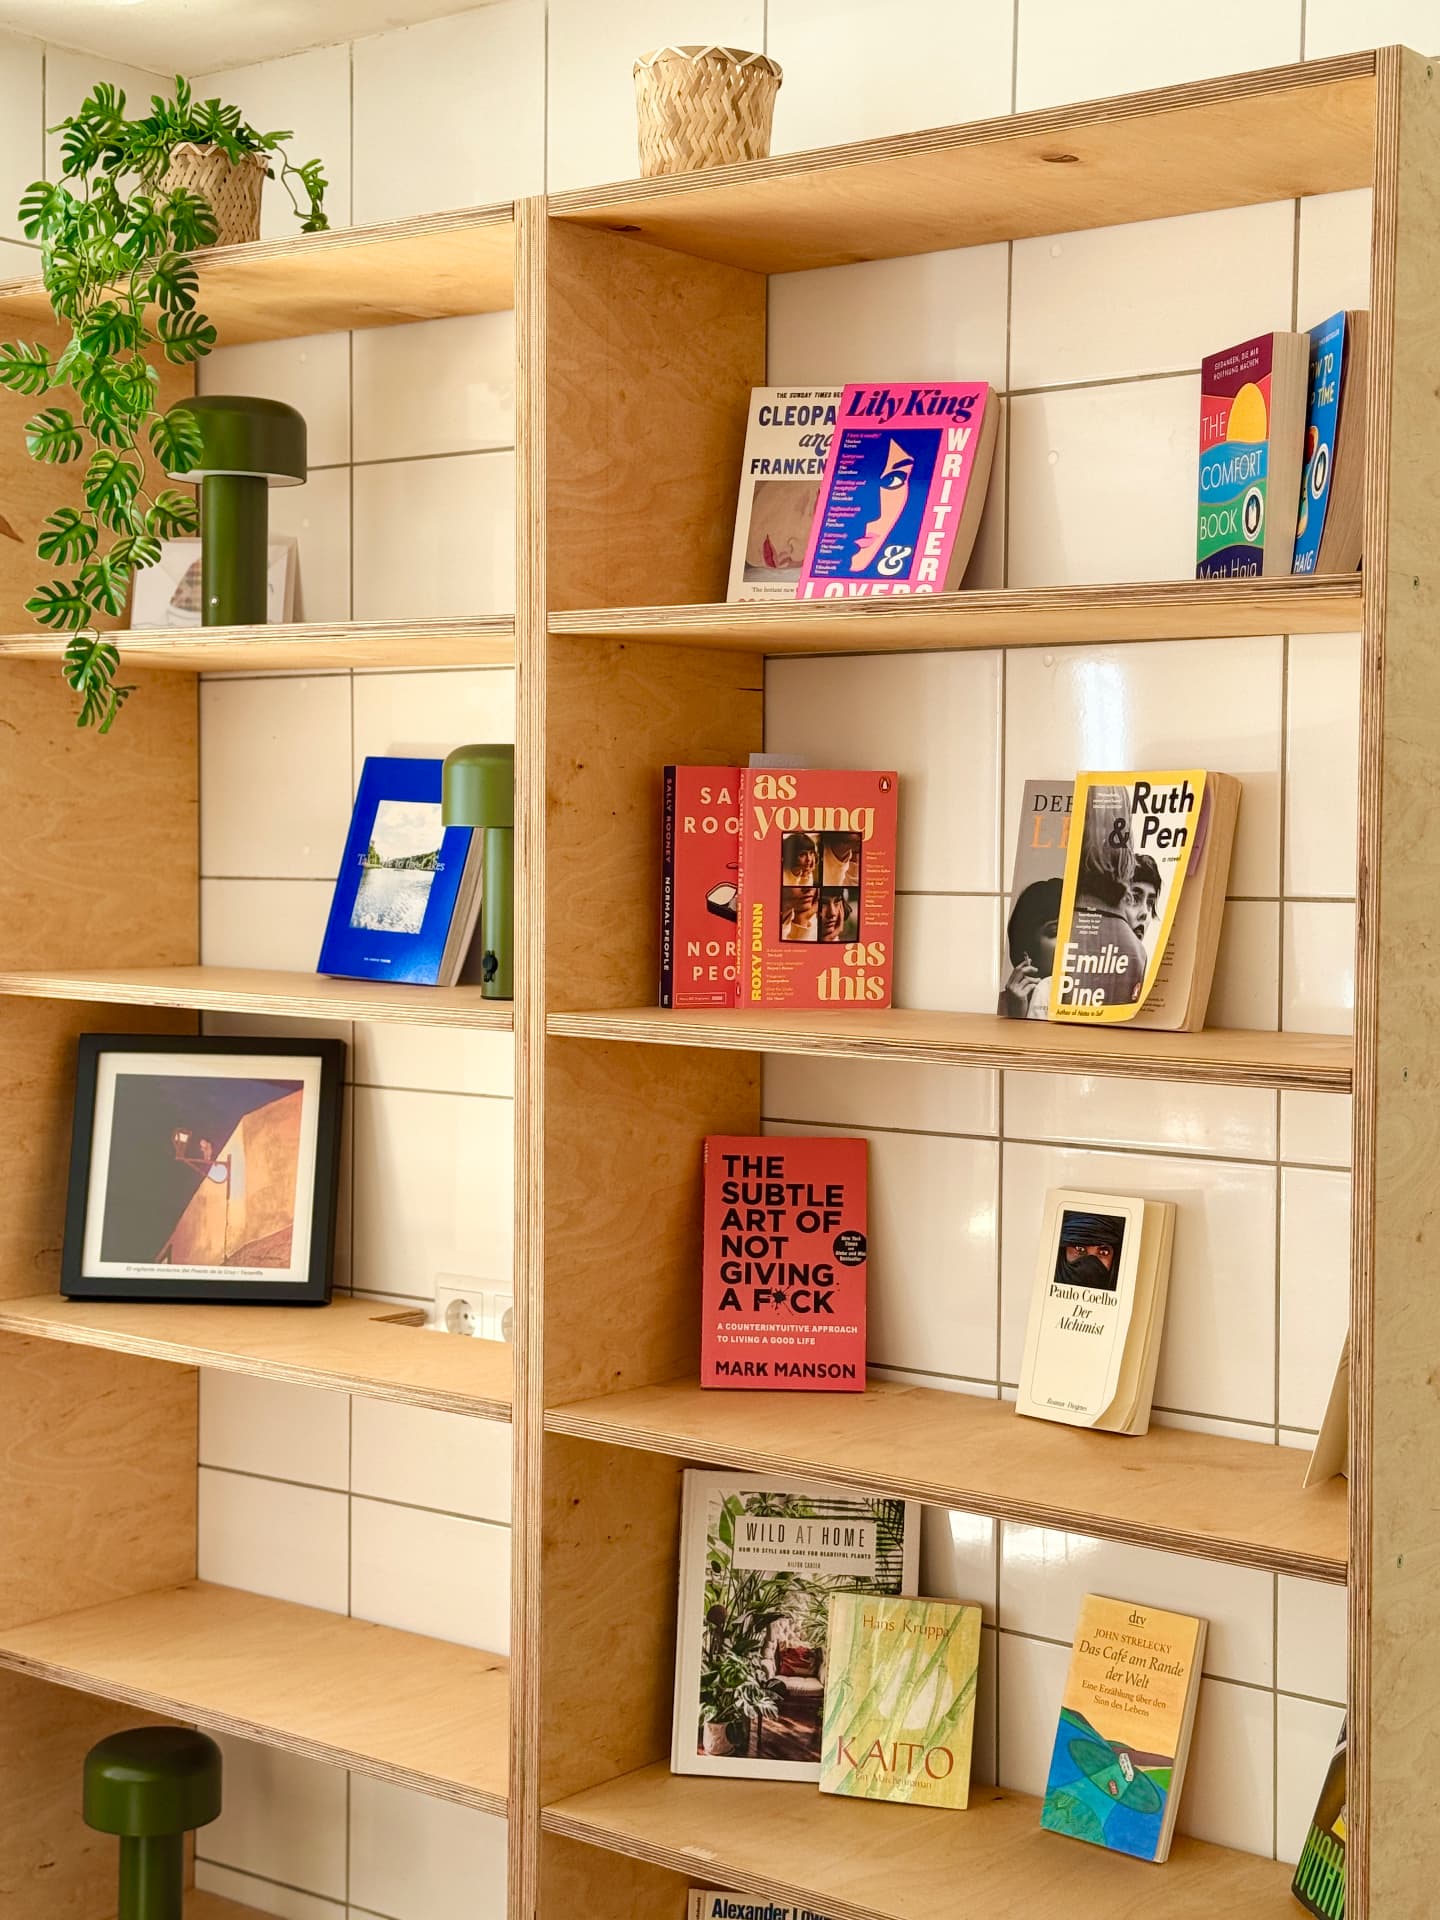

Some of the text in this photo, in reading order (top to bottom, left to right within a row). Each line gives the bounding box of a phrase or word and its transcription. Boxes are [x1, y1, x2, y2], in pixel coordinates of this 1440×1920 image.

[1324, 352, 1334, 374] TO
[846, 390, 980, 424] Lily King
[1317, 381, 1336, 408] TIME
[758, 405, 837, 426] CLEOPA
[1202, 411, 1226, 441] THE
[750, 458, 828, 475] FRANKEN
[1201, 450, 1263, 491] COMFORT
[1200, 508, 1238, 540] BOOK
[877, 545, 911, 576] &
[1200, 564, 1227, 579] Matt
[1293, 550, 1314, 573] HAIG
[700, 786, 733, 805] SA
[753, 774, 797, 800] as
[1131, 780, 1195, 815] Ruth
[684, 816, 740, 834] ROO
[753, 805, 876, 841] young
[1108, 815, 1188, 849] & Pen
[1169, 854, 1182, 863] novel
[687, 941, 736, 957] NOR
[751, 903, 763, 1001] ROXY DUNN
[843, 941, 886, 967] as
[1061, 942, 1129, 975] Emilie
[692, 965, 736, 981] PEO
[816, 967, 885, 1001] this
[1057, 975, 1105, 1008] Pine
[721, 1154, 784, 1179] THE
[721, 1181, 844, 1208] SUBTLE
[720, 1207, 842, 1234] ART OF
[721, 1234, 789, 1259] NOT
[720, 1261, 834, 1287] GIVING
[718, 1288, 743, 1312] A
[1049, 1284, 1118, 1306] Paulo Coelho
[1072, 1304, 1093, 1319] Der
[717, 1323, 858, 1334] A COUNTERINTUITIVE APPROACH
[1055, 1316, 1105, 1335] Alchimist
[731, 1335, 760, 1344] LIVING
[770, 1337, 795, 1345] GOOD
[715, 1361, 856, 1379] MARK MANSON
[746, 1522, 865, 1548] WILD AT HOME
[863, 1614, 949, 1640] Hans Kruppa
[1094, 1628, 1172, 1655] JOHN STRELECKY
[1079, 1640, 1184, 1677] Das Café am Rande
[1105, 1666, 1150, 1689] der Welt
[1081, 1679, 1166, 1709] Eine Erzählung über den
[1093, 1695, 1150, 1717] Sinn des Lebens
[837, 1735, 954, 1779] KAITO
[712, 1898, 789, 1920] Alexander
